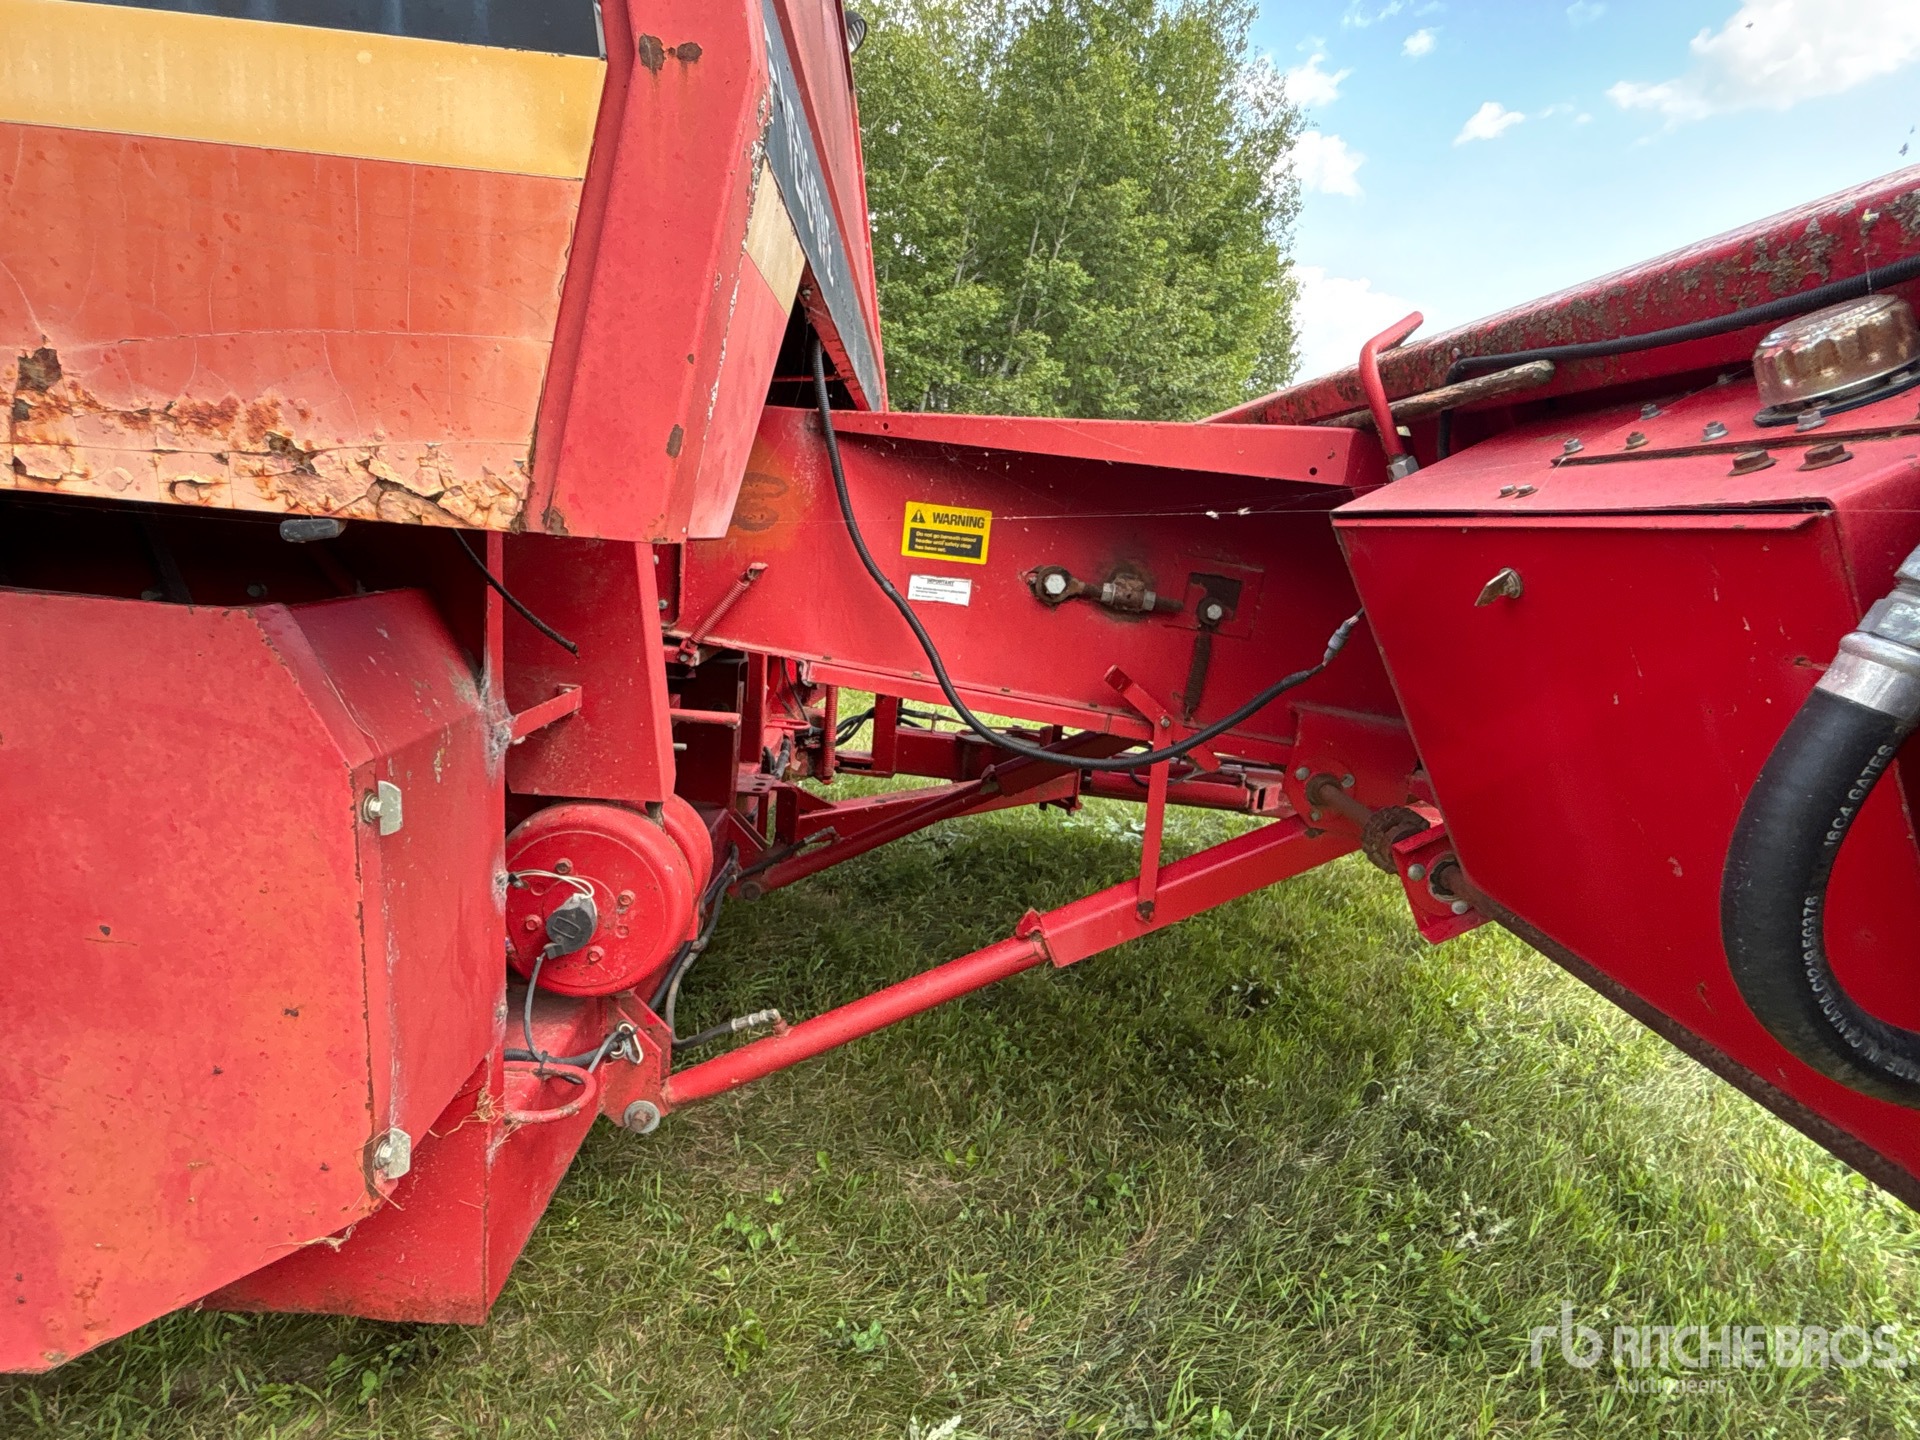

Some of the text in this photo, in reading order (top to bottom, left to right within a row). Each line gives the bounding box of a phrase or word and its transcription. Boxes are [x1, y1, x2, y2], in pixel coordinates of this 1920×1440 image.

[933, 512, 985, 529] WARNING
[1848, 744, 1895, 800] GATES
[1818, 992, 1863, 1048] CANADA
